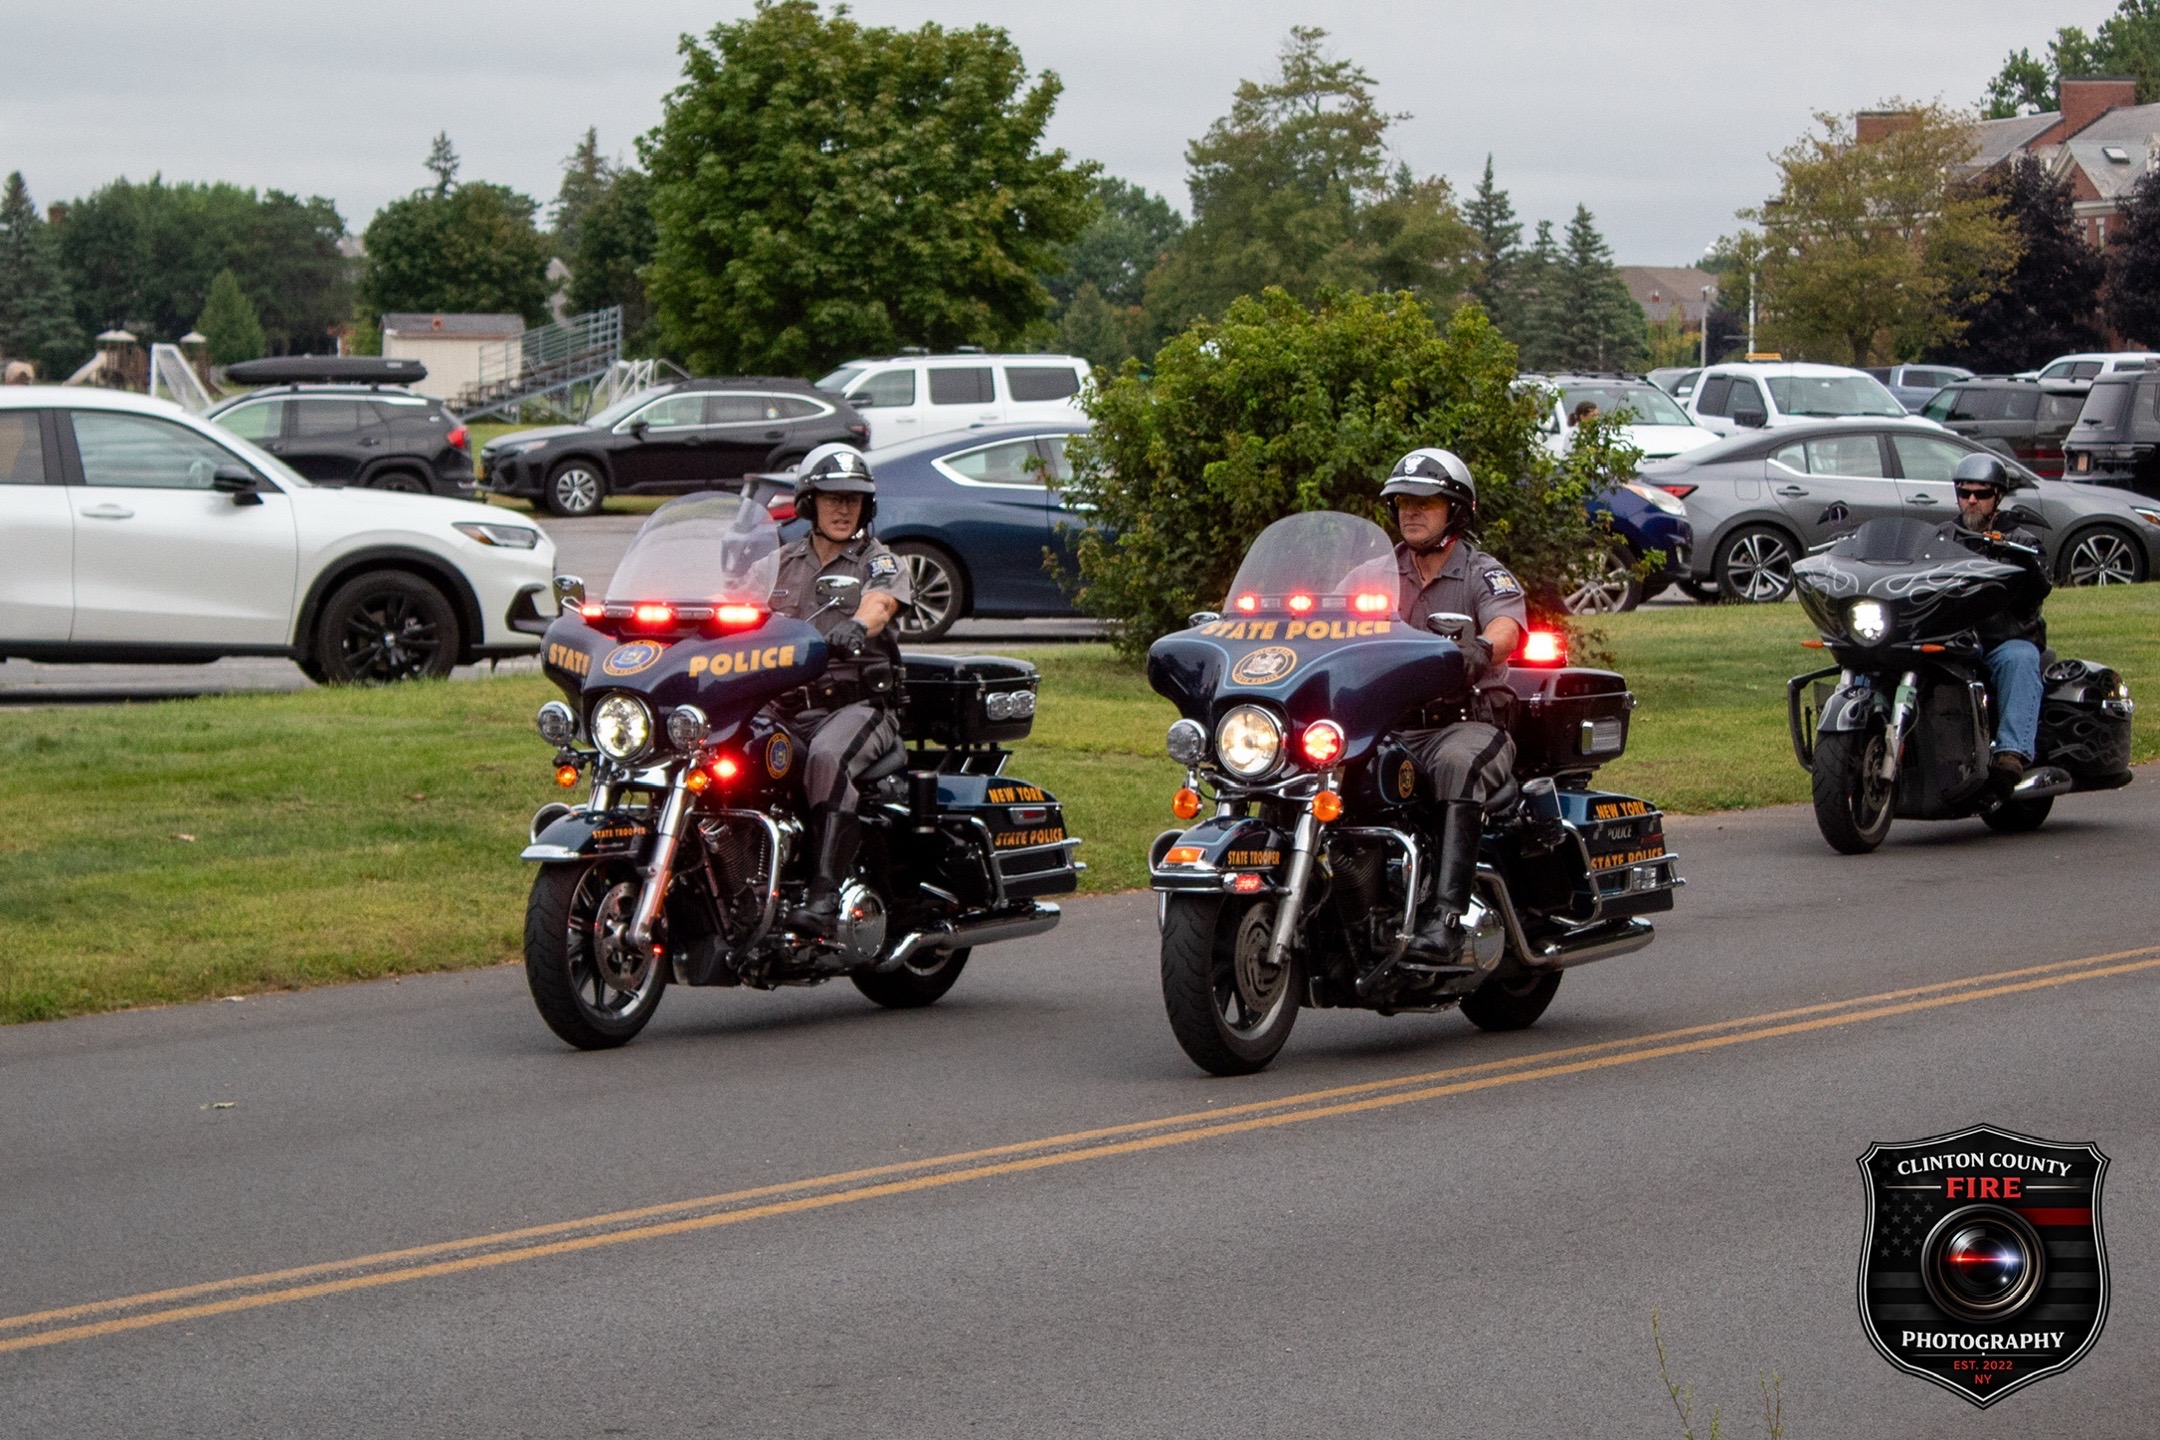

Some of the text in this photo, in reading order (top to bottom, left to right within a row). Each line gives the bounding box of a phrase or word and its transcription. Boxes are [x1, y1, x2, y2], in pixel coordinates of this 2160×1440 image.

[1200, 620, 1392, 640] STATE POLICE
[688, 645, 795, 678] POLICE
[988, 787, 1044, 804] NEW YORK
[1595, 800, 1648, 819] NEW YORK
[592, 827, 646, 839] STATE TROOPER
[995, 828, 1063, 846] STATE POLICE
[1607, 825, 1632, 840] POLICE
[1227, 850, 1281, 865] STATE TROOPER
[1590, 847, 1663, 869] STATE POLICE
